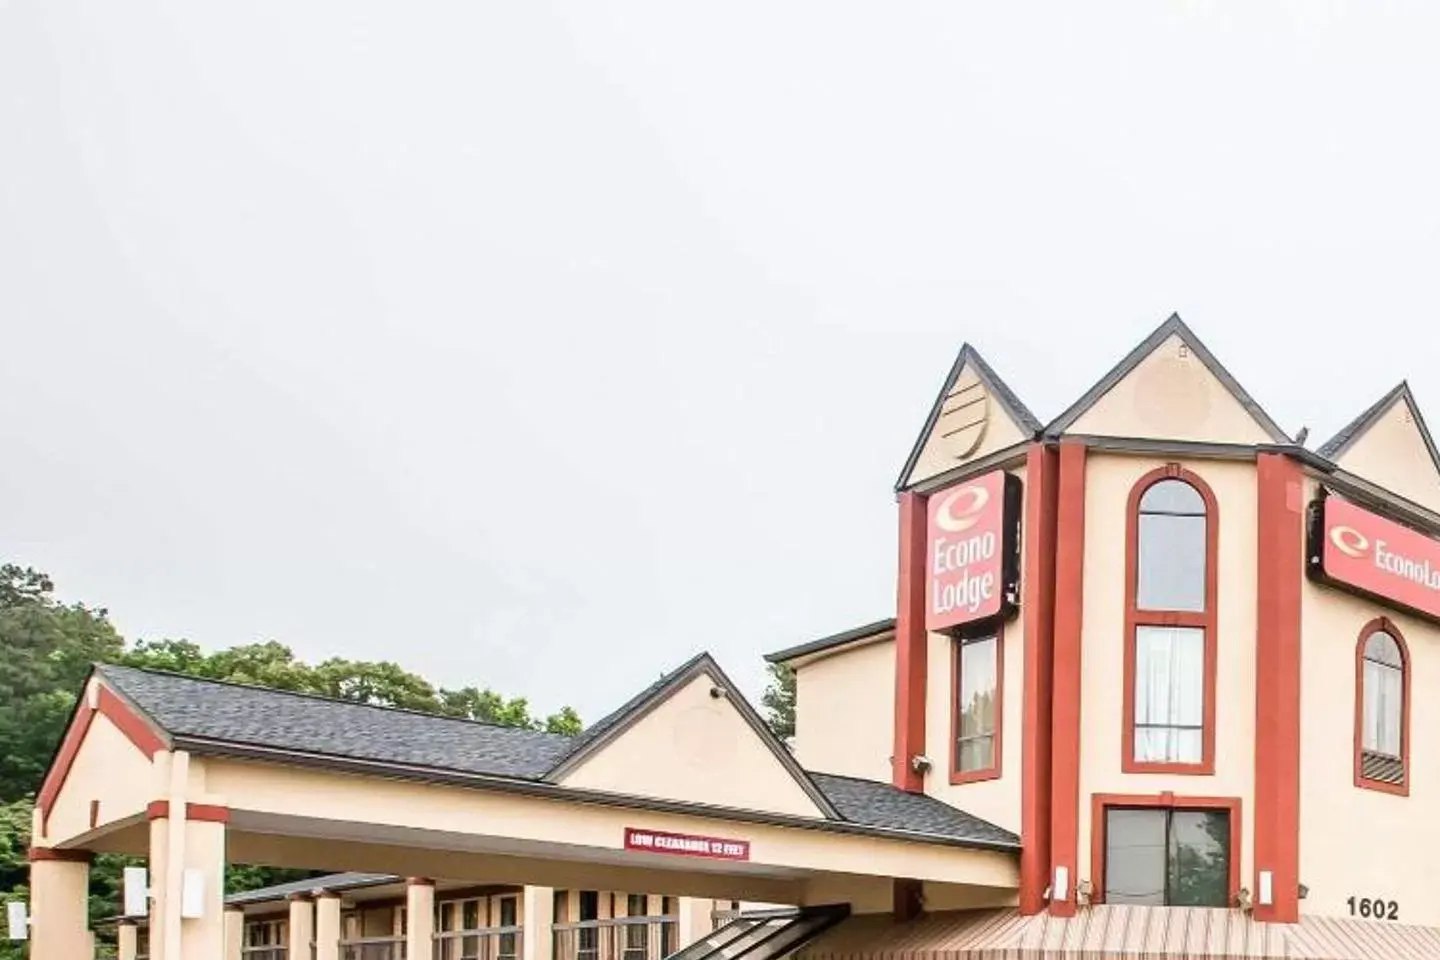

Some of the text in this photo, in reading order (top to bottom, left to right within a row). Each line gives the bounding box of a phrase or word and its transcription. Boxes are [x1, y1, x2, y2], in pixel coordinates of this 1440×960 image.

[934, 532, 994, 574] Econo
[933, 569, 994, 613] Lodge
[630, 833, 653, 847] LOW
[1347, 896, 1399, 920] 1602
